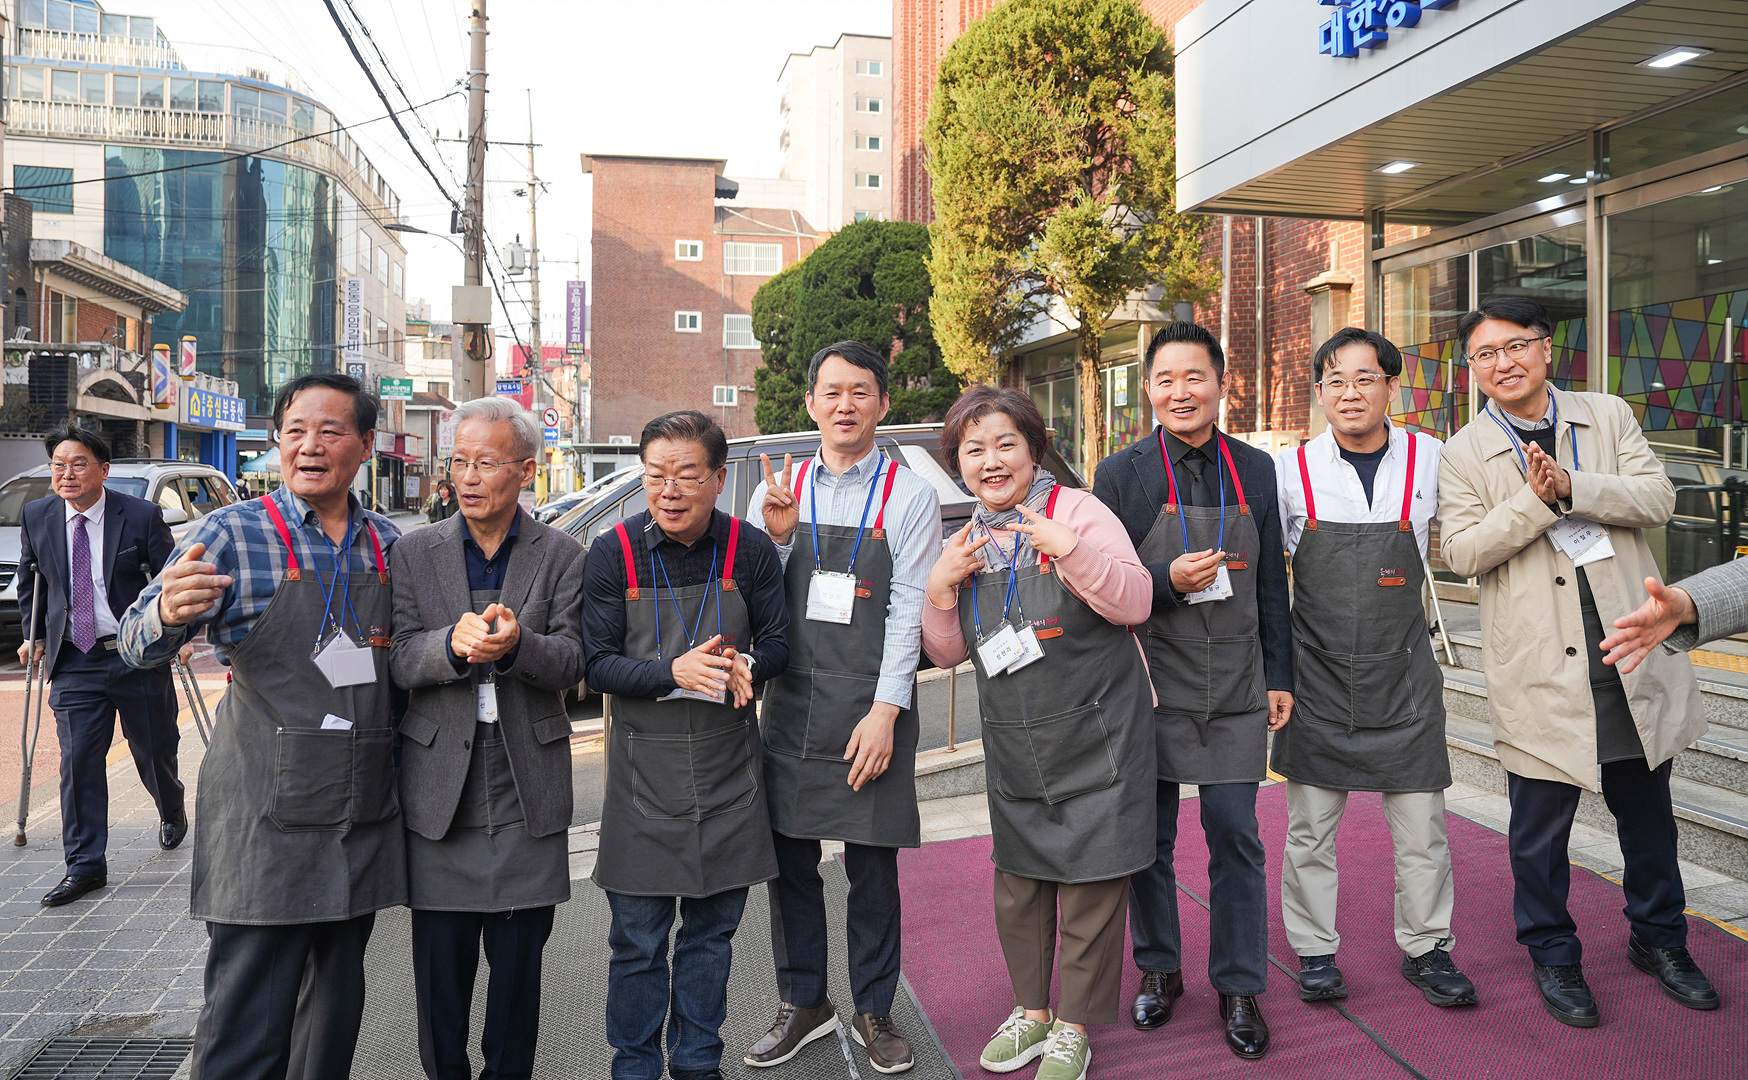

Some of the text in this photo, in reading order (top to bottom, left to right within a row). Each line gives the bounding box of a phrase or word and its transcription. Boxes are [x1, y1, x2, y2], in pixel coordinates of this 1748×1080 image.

[1318, 0, 1445, 58] 대한성
[571, 288, 581, 343] 은평성결교회
[349, 364, 363, 374] GS
[206, 395, 244, 423] 중심부동산
